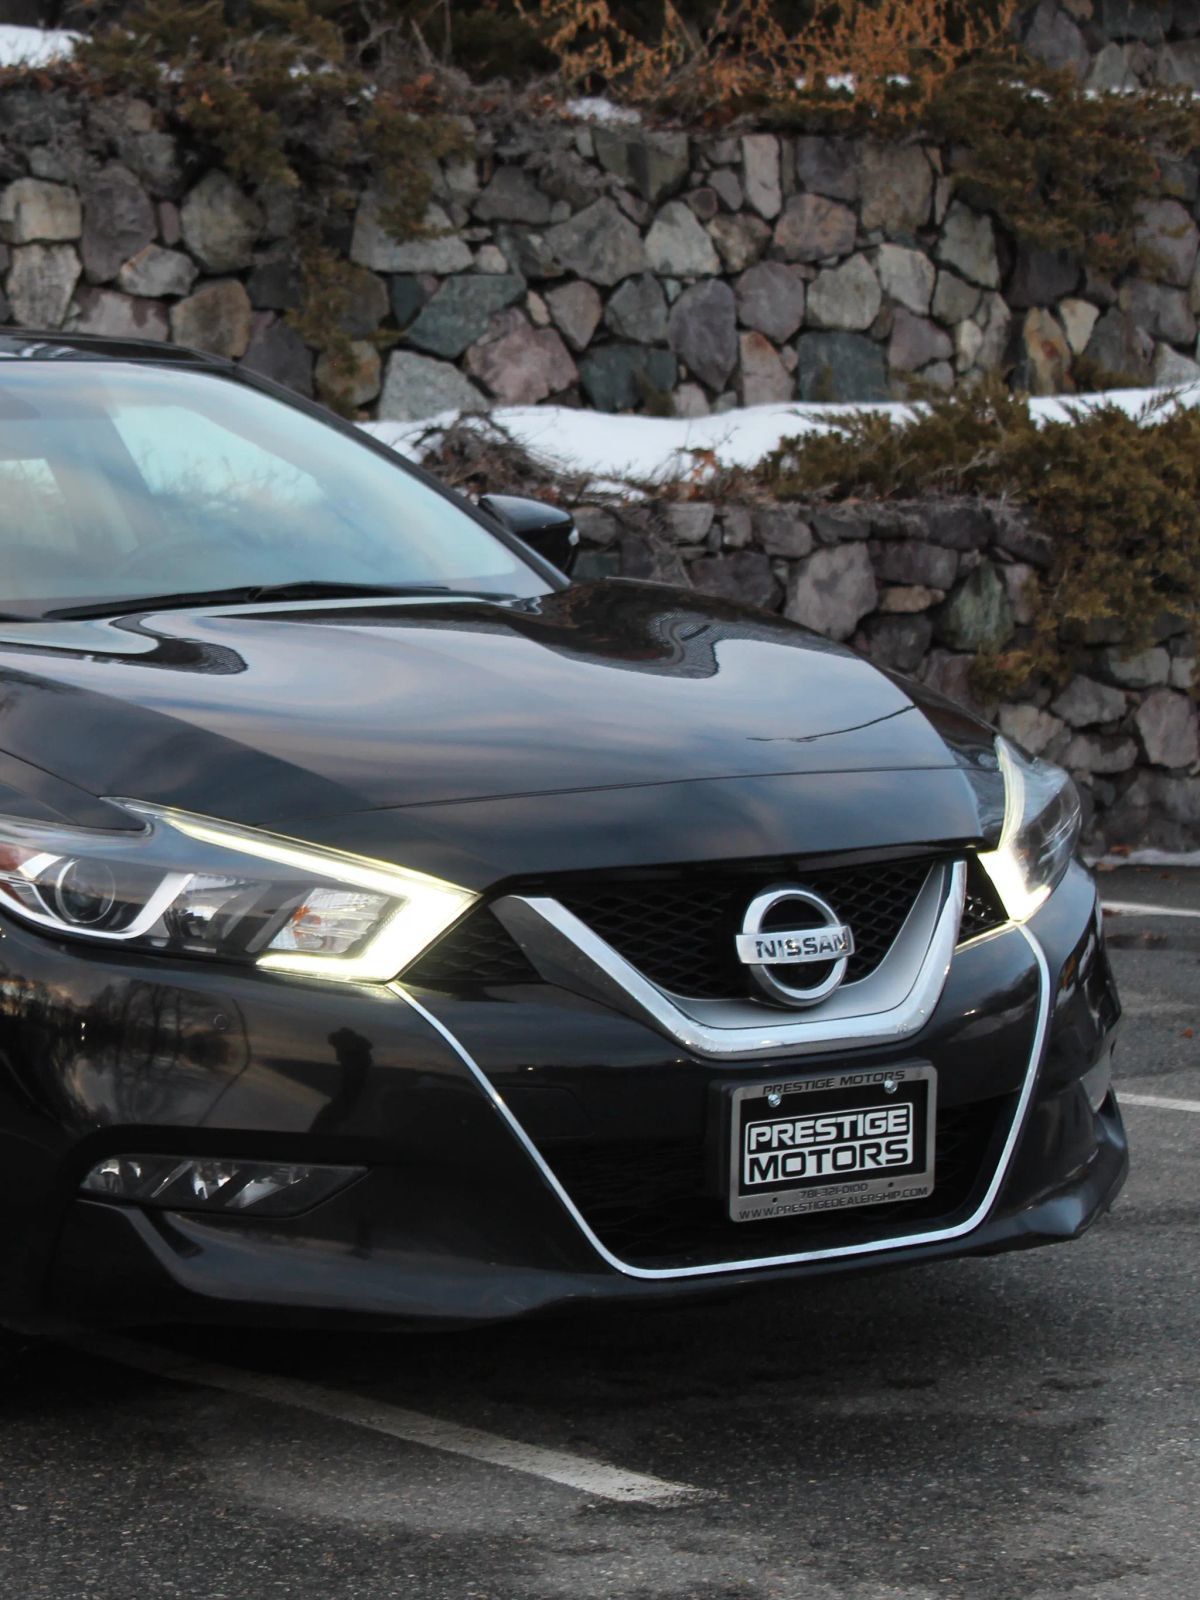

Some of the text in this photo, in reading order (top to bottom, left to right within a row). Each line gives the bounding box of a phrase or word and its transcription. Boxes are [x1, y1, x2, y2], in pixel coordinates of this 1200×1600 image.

[755, 932, 848, 958] NISSAN
[762, 1070, 906, 1095] PRESTIGE MOTORS
[749, 1108, 908, 1151] PRESTIGE
[749, 1138, 908, 1182] MOTORS
[739, 1187, 928, 1220] WWW.PRESTIGEDEALERSHIP.COM
